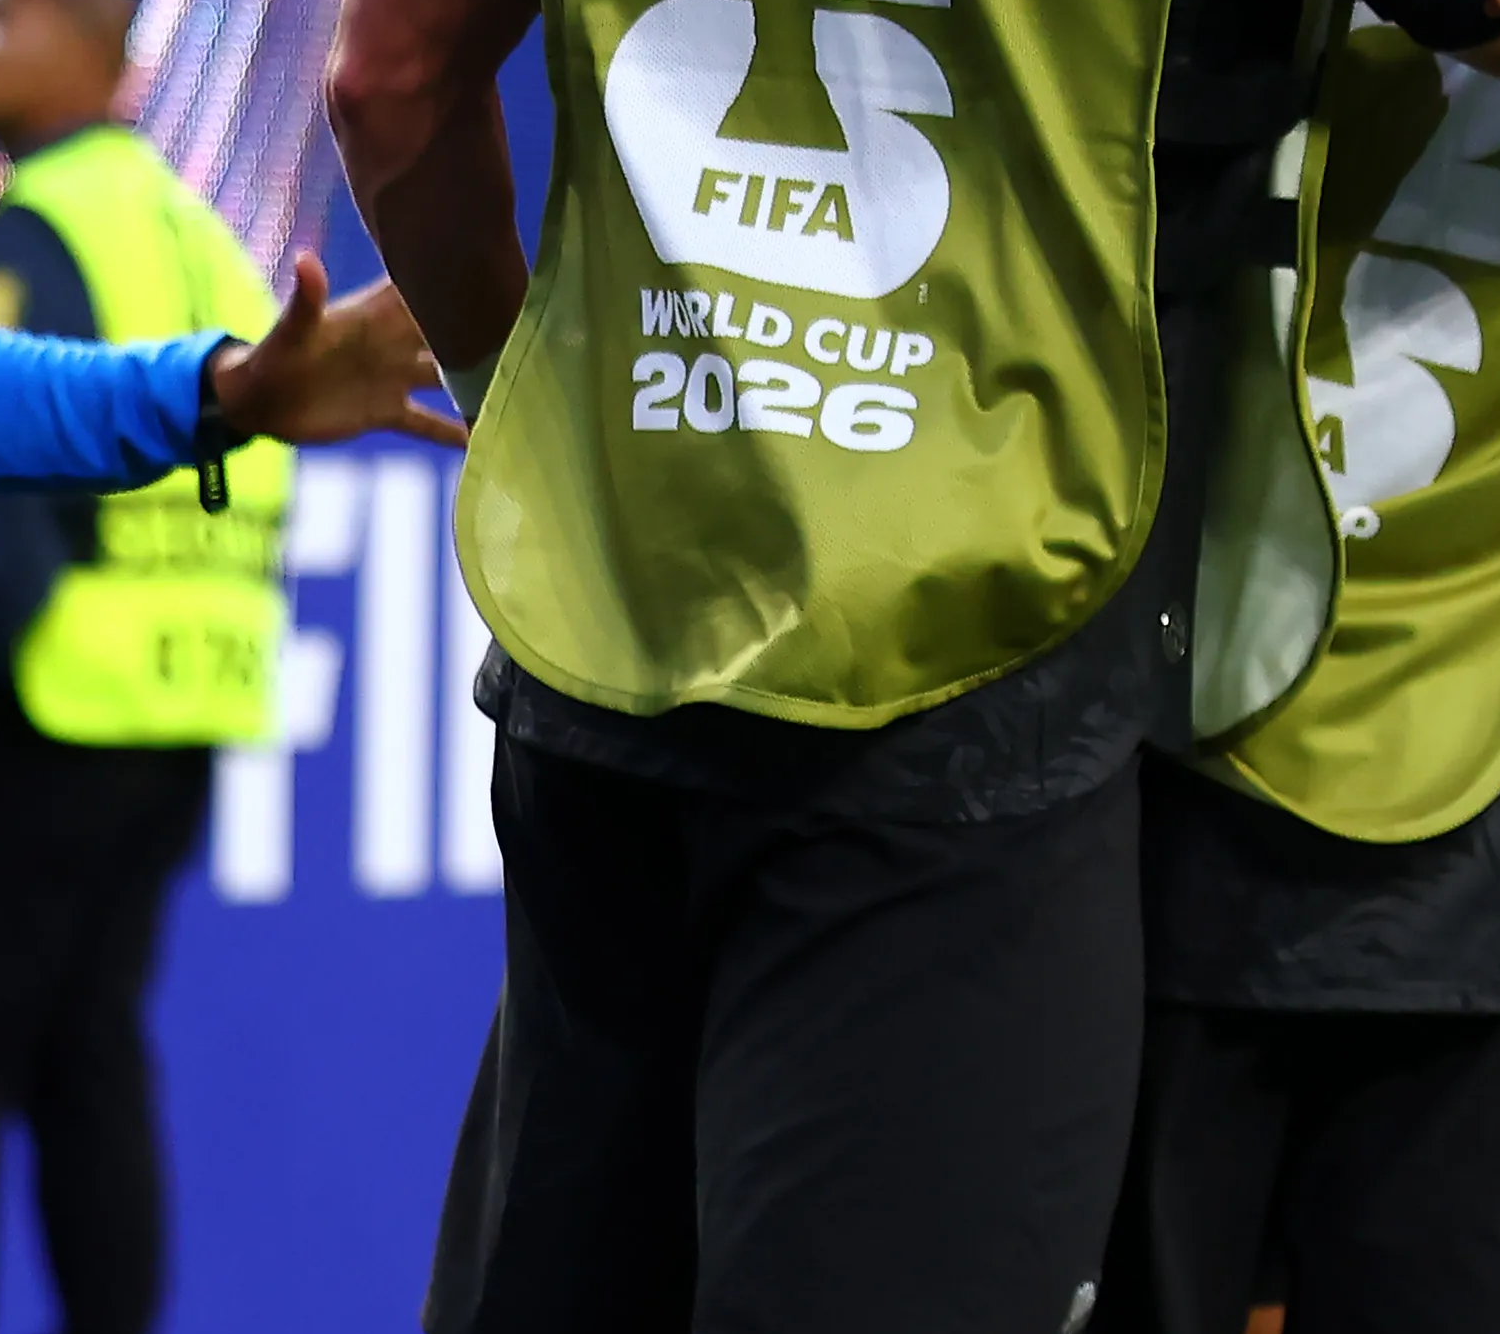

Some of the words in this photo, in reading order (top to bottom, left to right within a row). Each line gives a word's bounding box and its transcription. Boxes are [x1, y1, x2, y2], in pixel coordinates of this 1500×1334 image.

[693, 168, 855, 244] FIFA
[640, 286, 794, 348] WORLD
[803, 317, 935, 377] CUP
[632, 350, 919, 453] 2026
